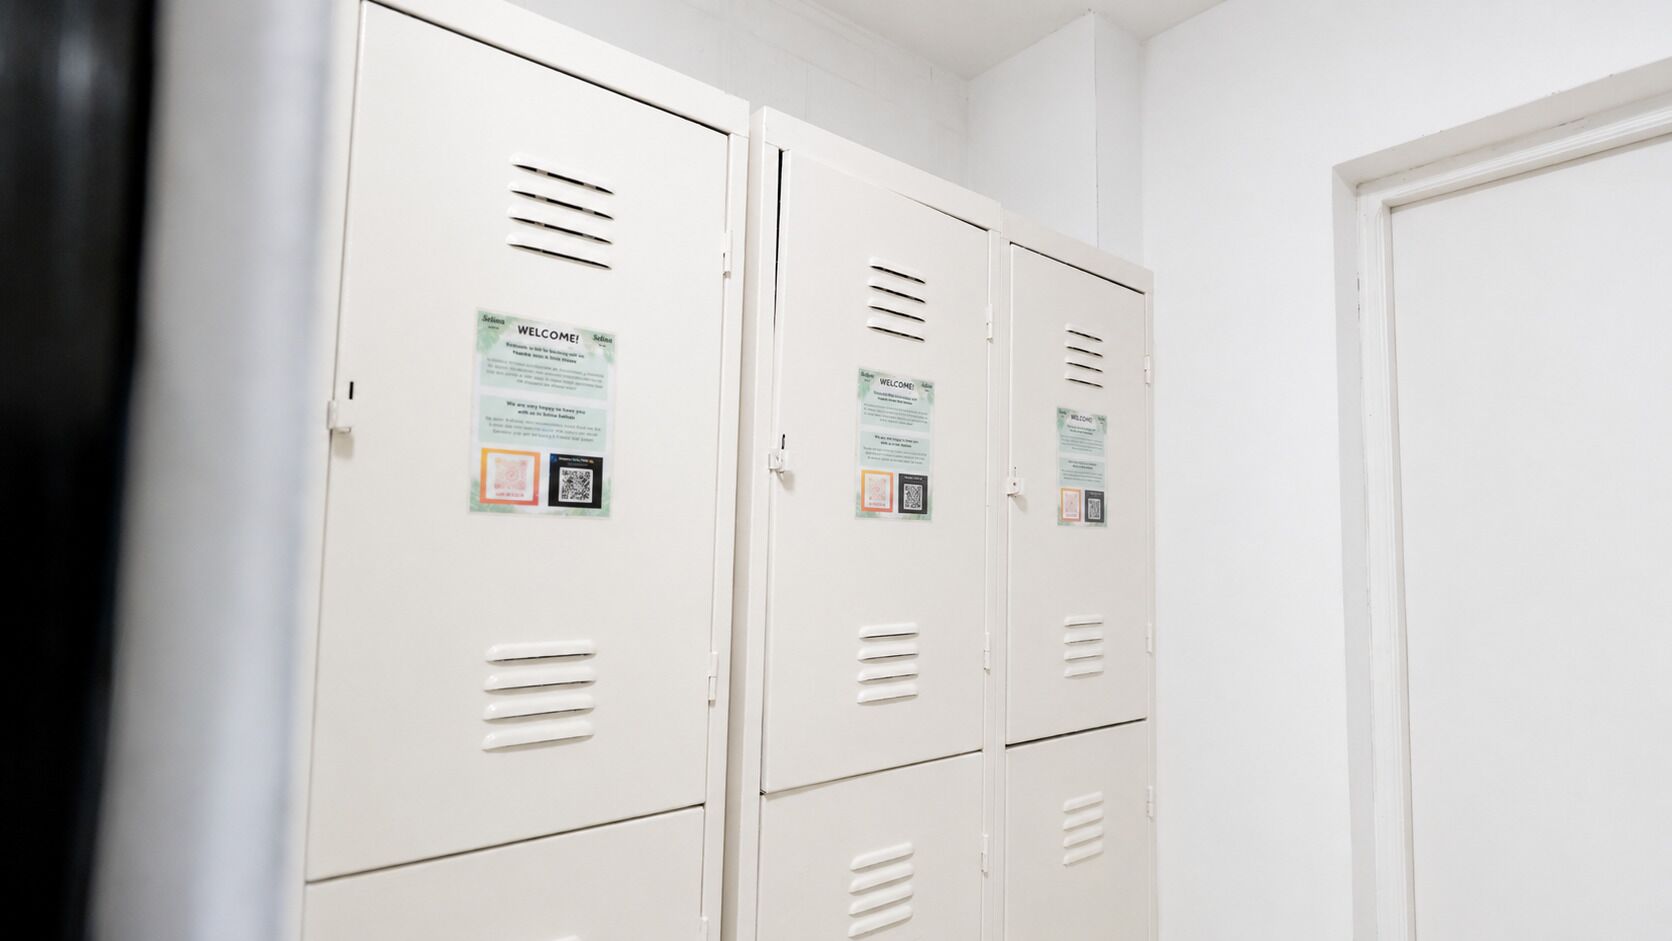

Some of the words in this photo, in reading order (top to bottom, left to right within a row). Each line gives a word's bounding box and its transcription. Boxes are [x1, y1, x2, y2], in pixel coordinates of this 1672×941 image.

[481, 314, 505, 325] Selina
[517, 325, 579, 345] WELCOME!
[880, 378, 915, 391] WELCOME!
